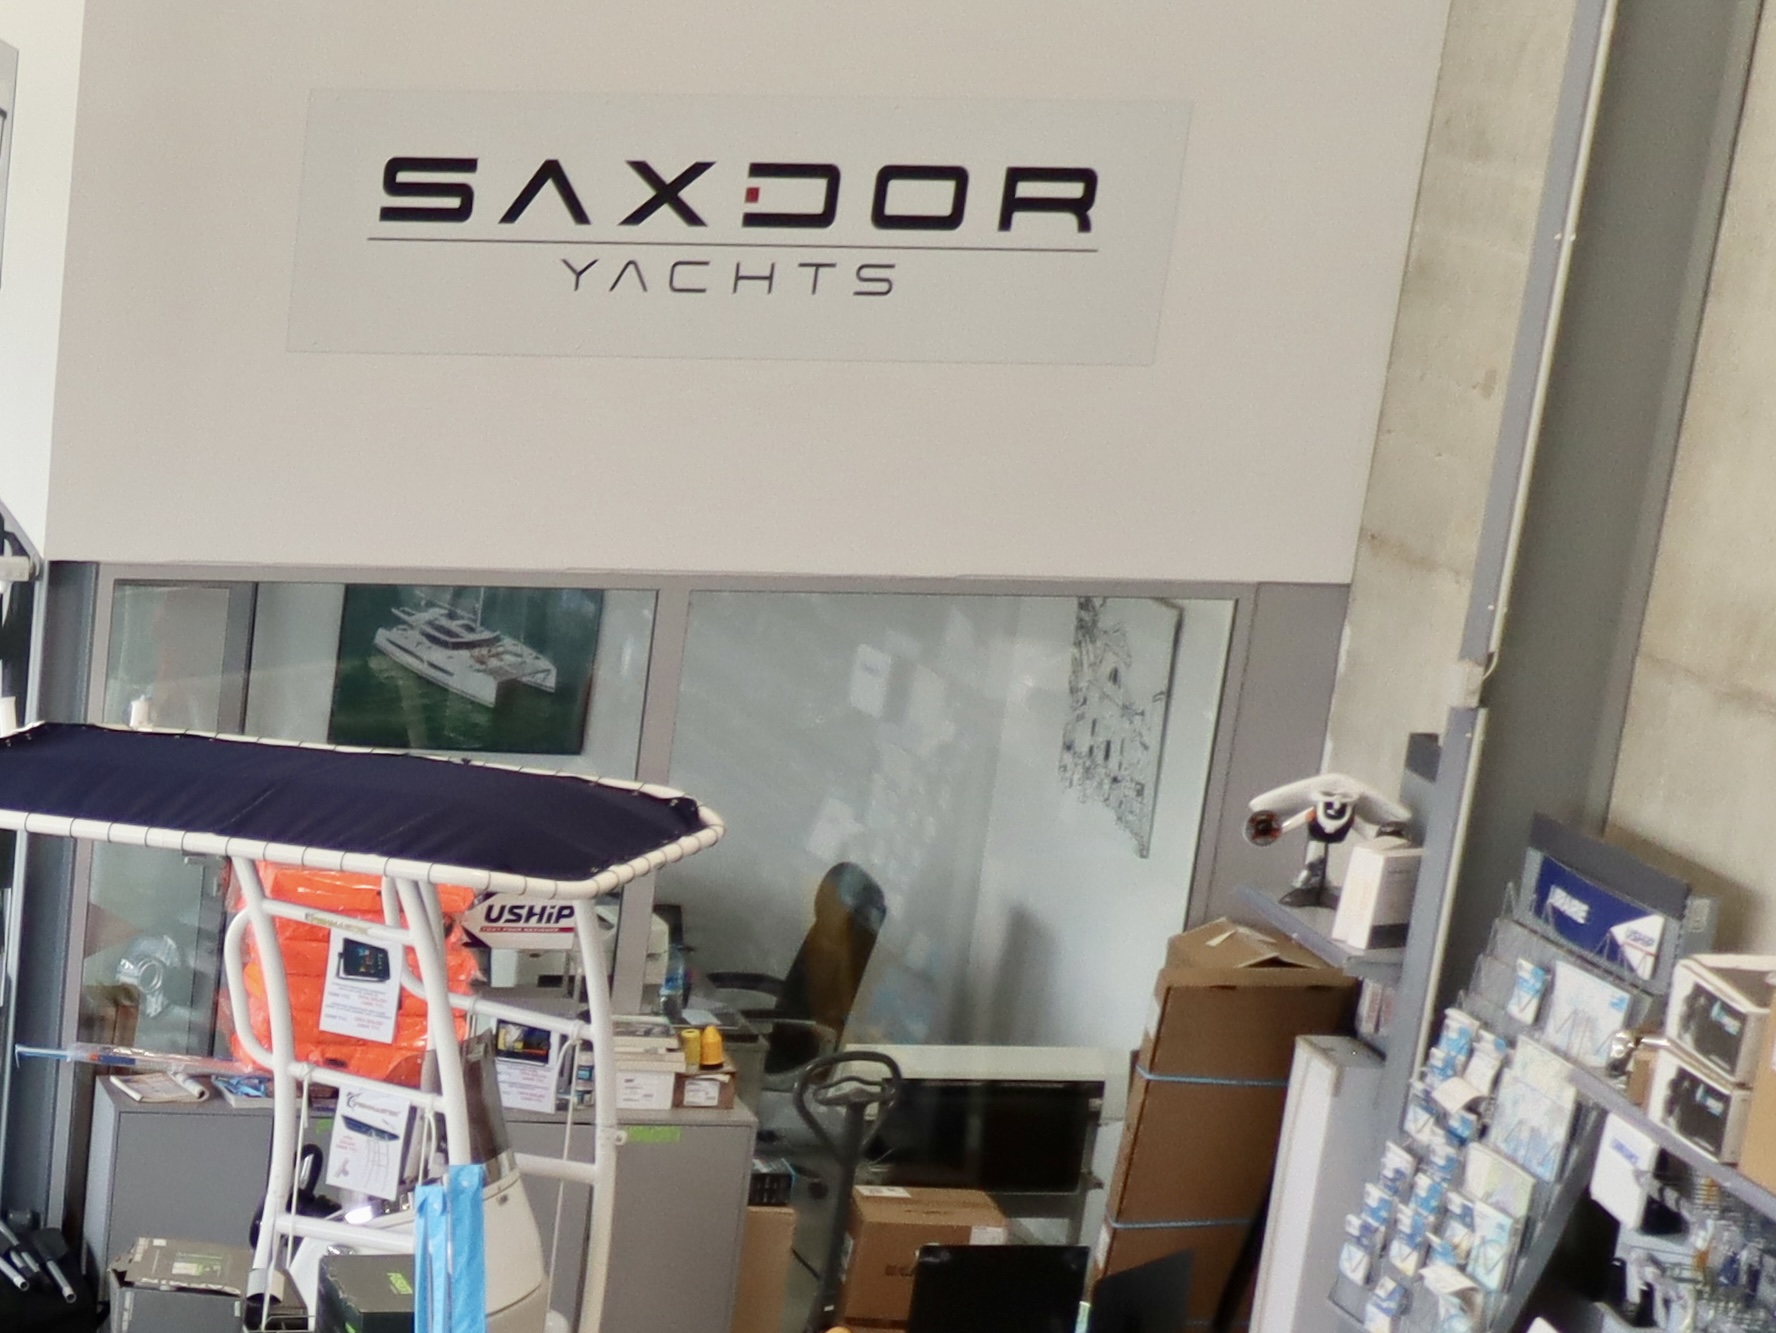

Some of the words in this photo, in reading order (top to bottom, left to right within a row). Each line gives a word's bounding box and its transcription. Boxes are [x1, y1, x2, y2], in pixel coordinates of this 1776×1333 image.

[379, 156, 1099, 233] SAXDOR
[561, 258, 896, 297] YACHTS
[483, 903, 576, 925] USHiP
